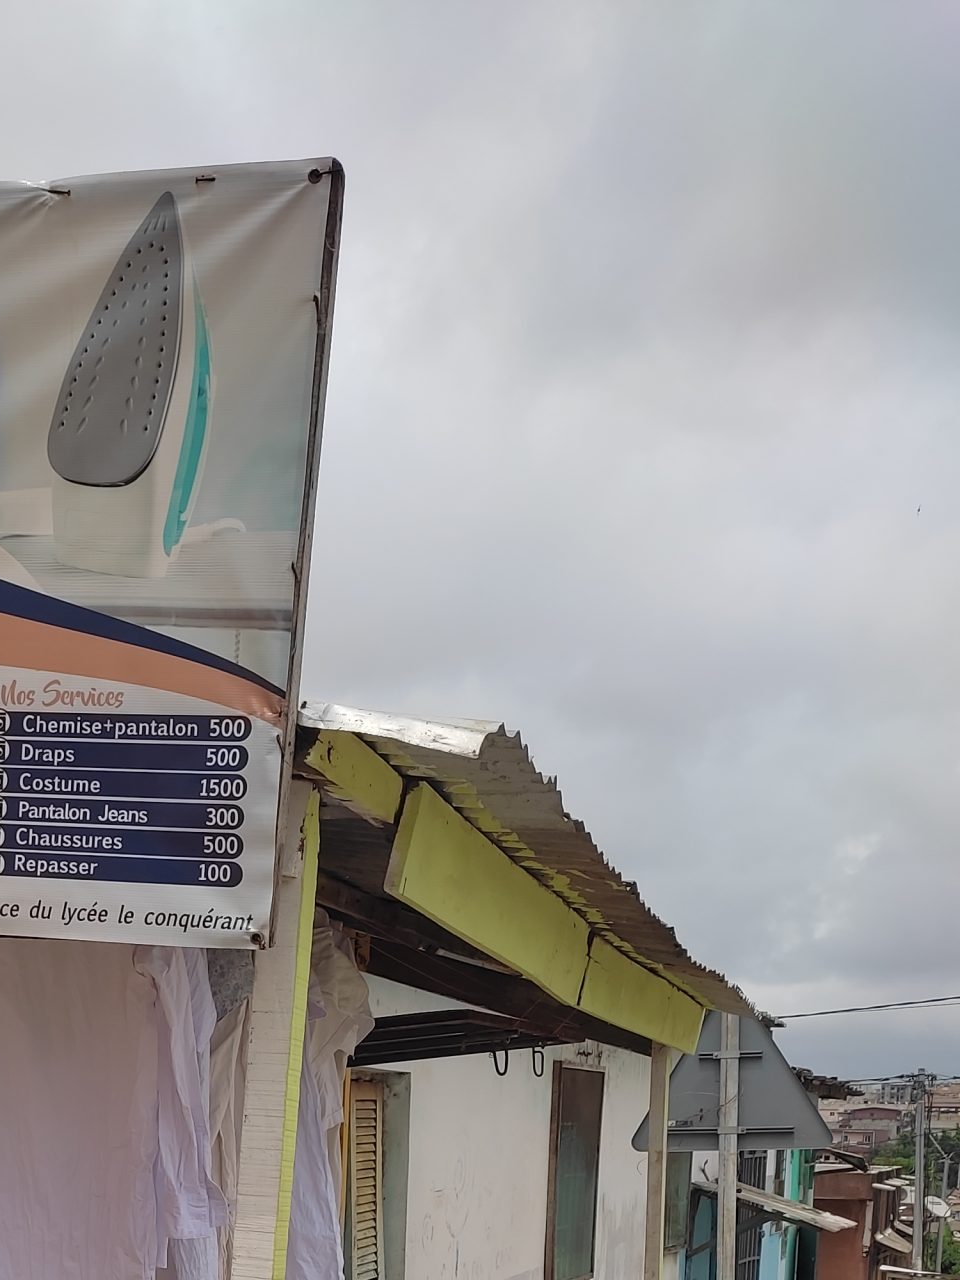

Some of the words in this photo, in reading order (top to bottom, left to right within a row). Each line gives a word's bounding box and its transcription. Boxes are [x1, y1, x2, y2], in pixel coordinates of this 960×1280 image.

[0, 679, 36, 707] Nos
[41, 679, 124, 708] Services
[22, 714, 199, 739] Chemise+pantalon
[208, 718, 245, 738] 500
[20, 743, 75, 766] Draps
[205, 748, 240, 767] 500
[18, 772, 101, 793] Costume
[199, 778, 244, 798] 1500
[18, 801, 90, 821] Pantalon
[97, 804, 148, 824] Jeans
[205, 807, 239, 826] 300
[15, 828, 123, 849] Chaussures
[202, 835, 238, 854] 500
[14, 854, 98, 876] Repasser
[197, 863, 232, 882] 100
[29, 899, 53, 919] du
[61, 901, 108, 926] lycée
[118, 904, 135, 925] le
[144, 908, 254, 933] conquérant
